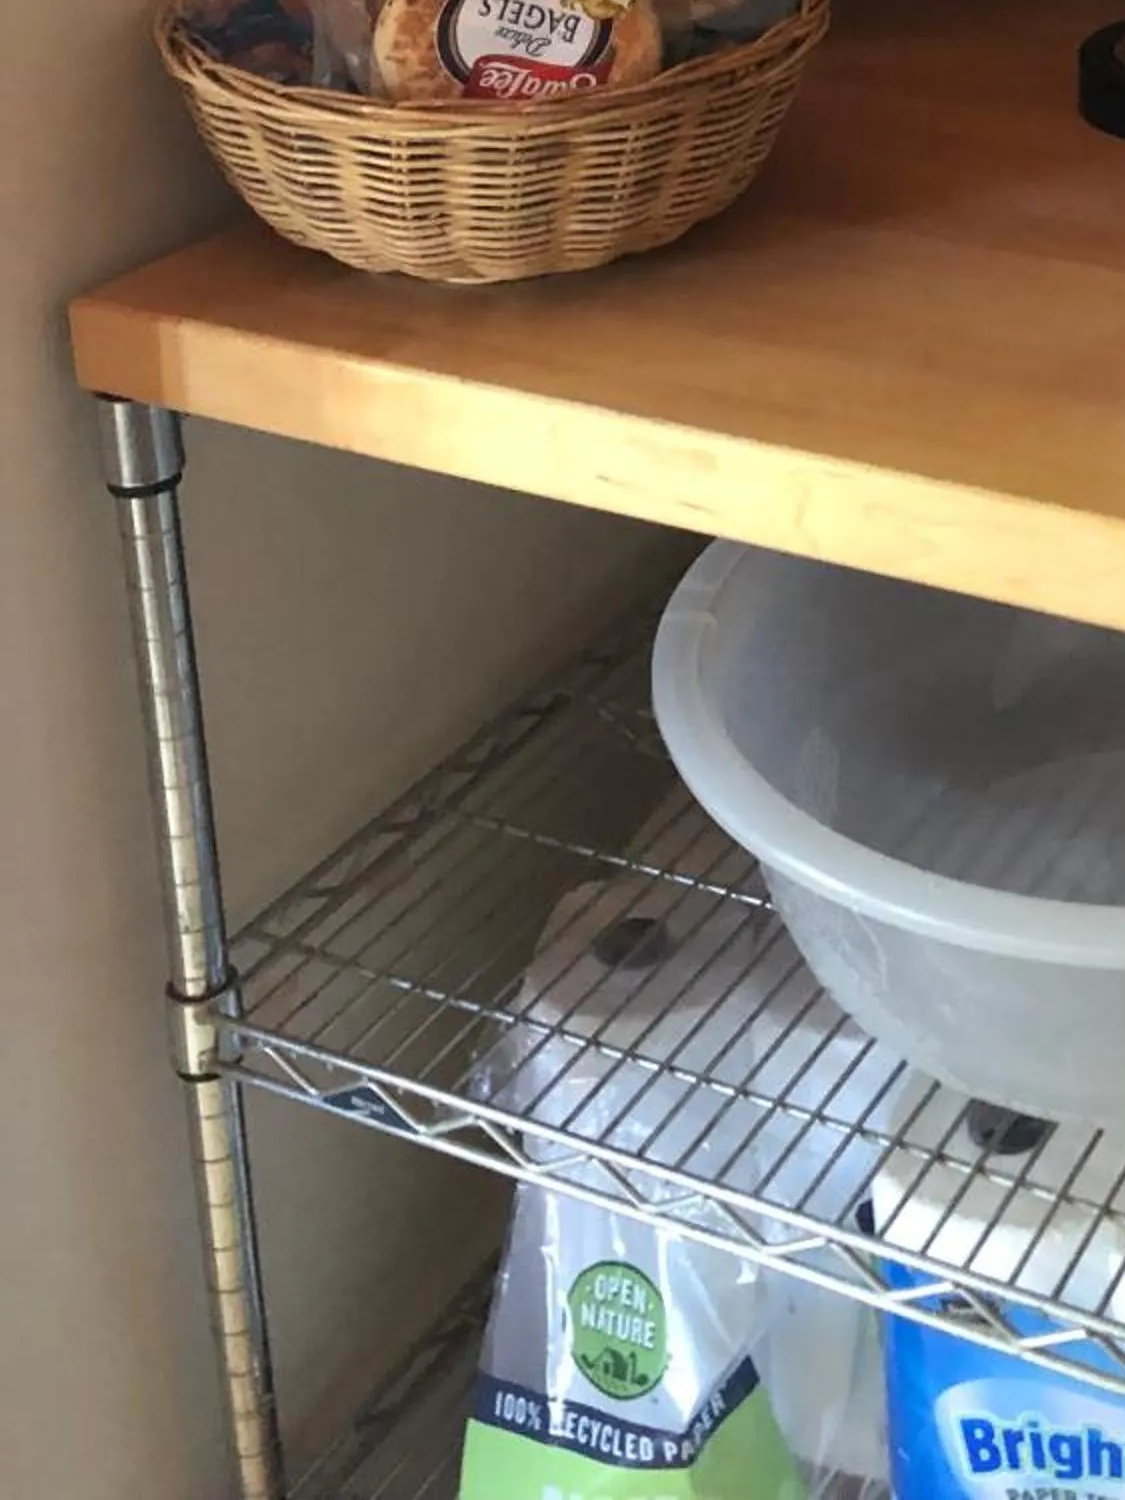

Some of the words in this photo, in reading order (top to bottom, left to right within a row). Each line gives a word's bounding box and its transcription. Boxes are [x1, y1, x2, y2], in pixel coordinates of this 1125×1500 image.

[494, 26, 552, 57] Deluxe
[593, 1273, 648, 1314] OPEN
[580, 1303, 657, 1349] NATURE
[494, 1392, 541, 1431] 100%
